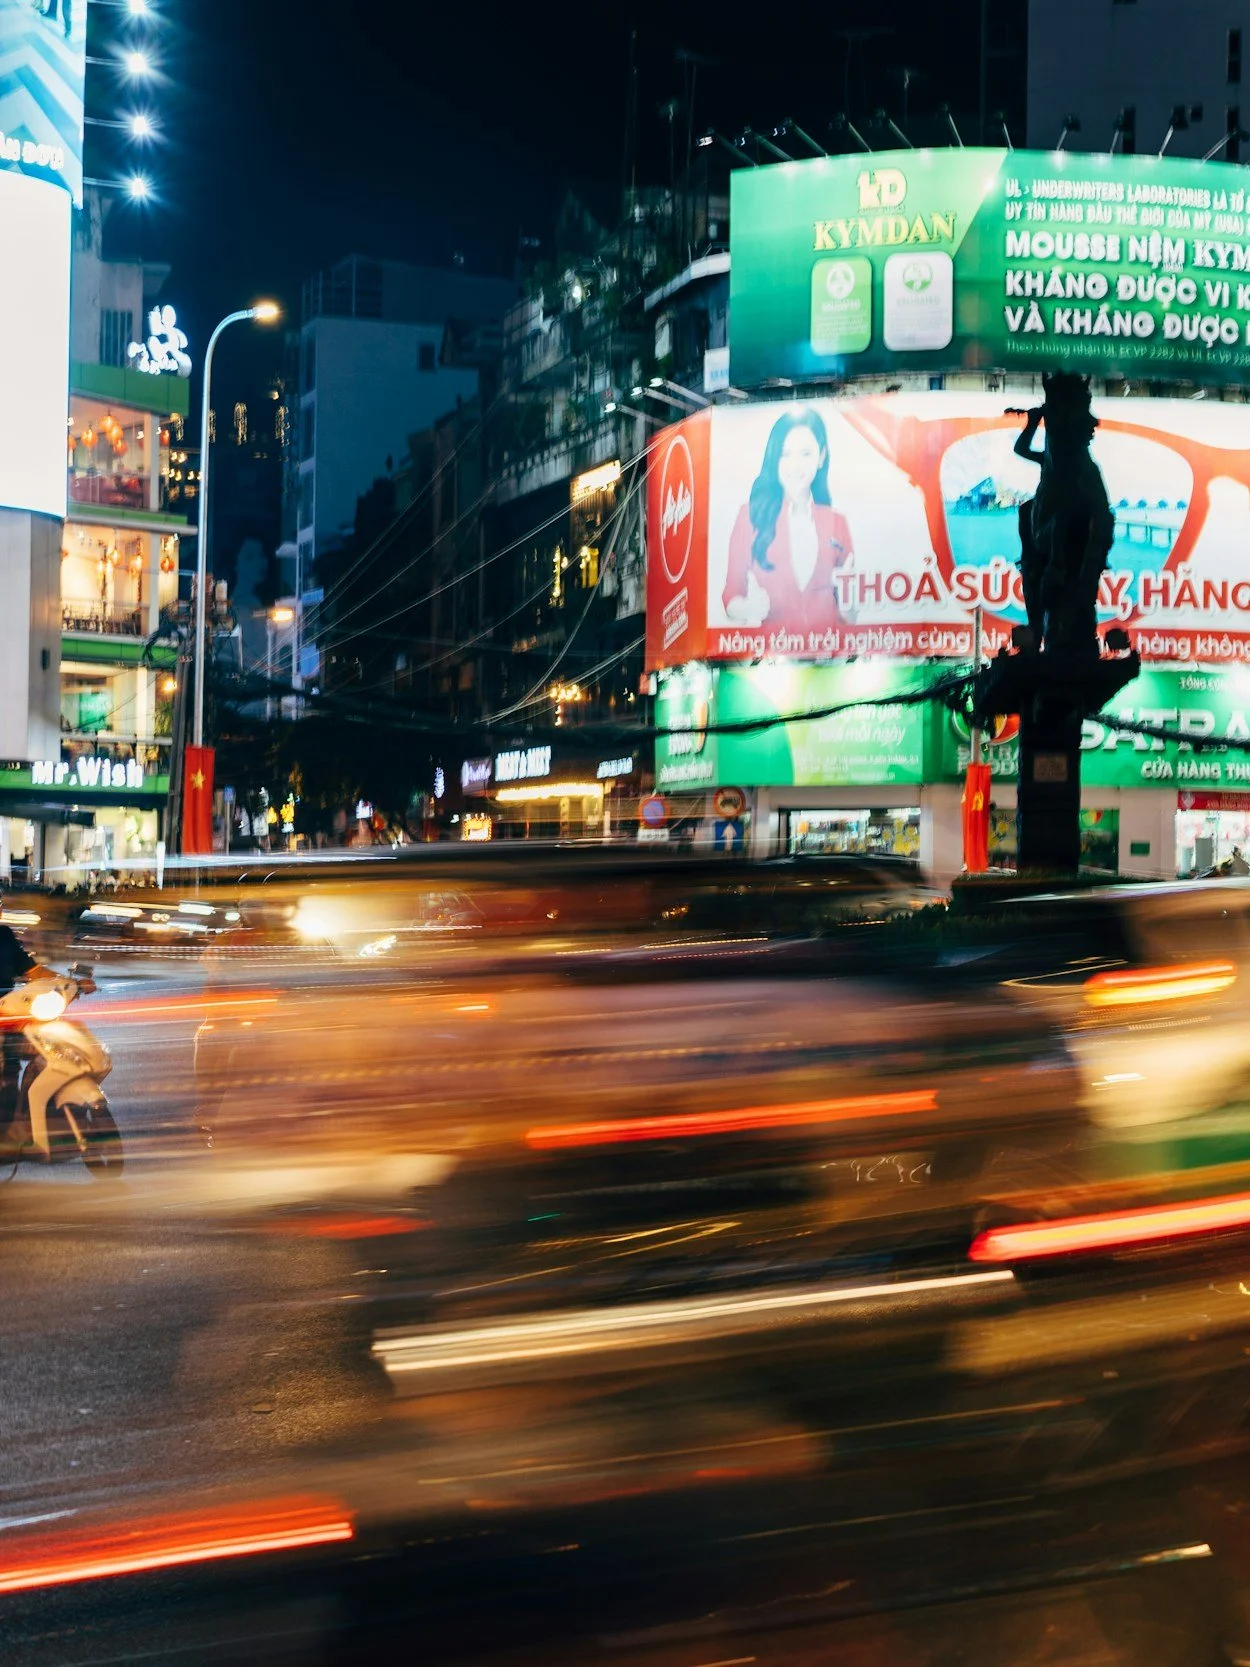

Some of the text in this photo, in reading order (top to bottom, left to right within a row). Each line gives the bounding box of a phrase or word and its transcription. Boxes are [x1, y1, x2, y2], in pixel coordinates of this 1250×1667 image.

[1031, 179, 1125, 203] UNDERWRITERS
[1127, 184, 1211, 209] LABORATORIES
[813, 211, 958, 251] KYMDAN
[1005, 230, 1121, 262] MOUSSE
[1128, 229, 1186, 269] NỆM
[1005, 265, 1109, 300] KHÁNG
[1116, 273, 1198, 310] ĐƯỢC
[1204, 279, 1230, 309] VI
[1004, 299, 1045, 333] VÀ
[1054, 303, 1155, 338] KHÁNG
[1163, 312, 1239, 348] ĐƯỢC
[836, 556, 940, 601] THOẢ
[719, 632, 765, 655] Nâng
[809, 626, 840, 651] trải
[844, 627, 913, 654] nghiệm
[917, 625, 971, 654] cùng
[1141, 757, 1173, 778] CỬA
[1177, 759, 1221, 779] HÀNG
